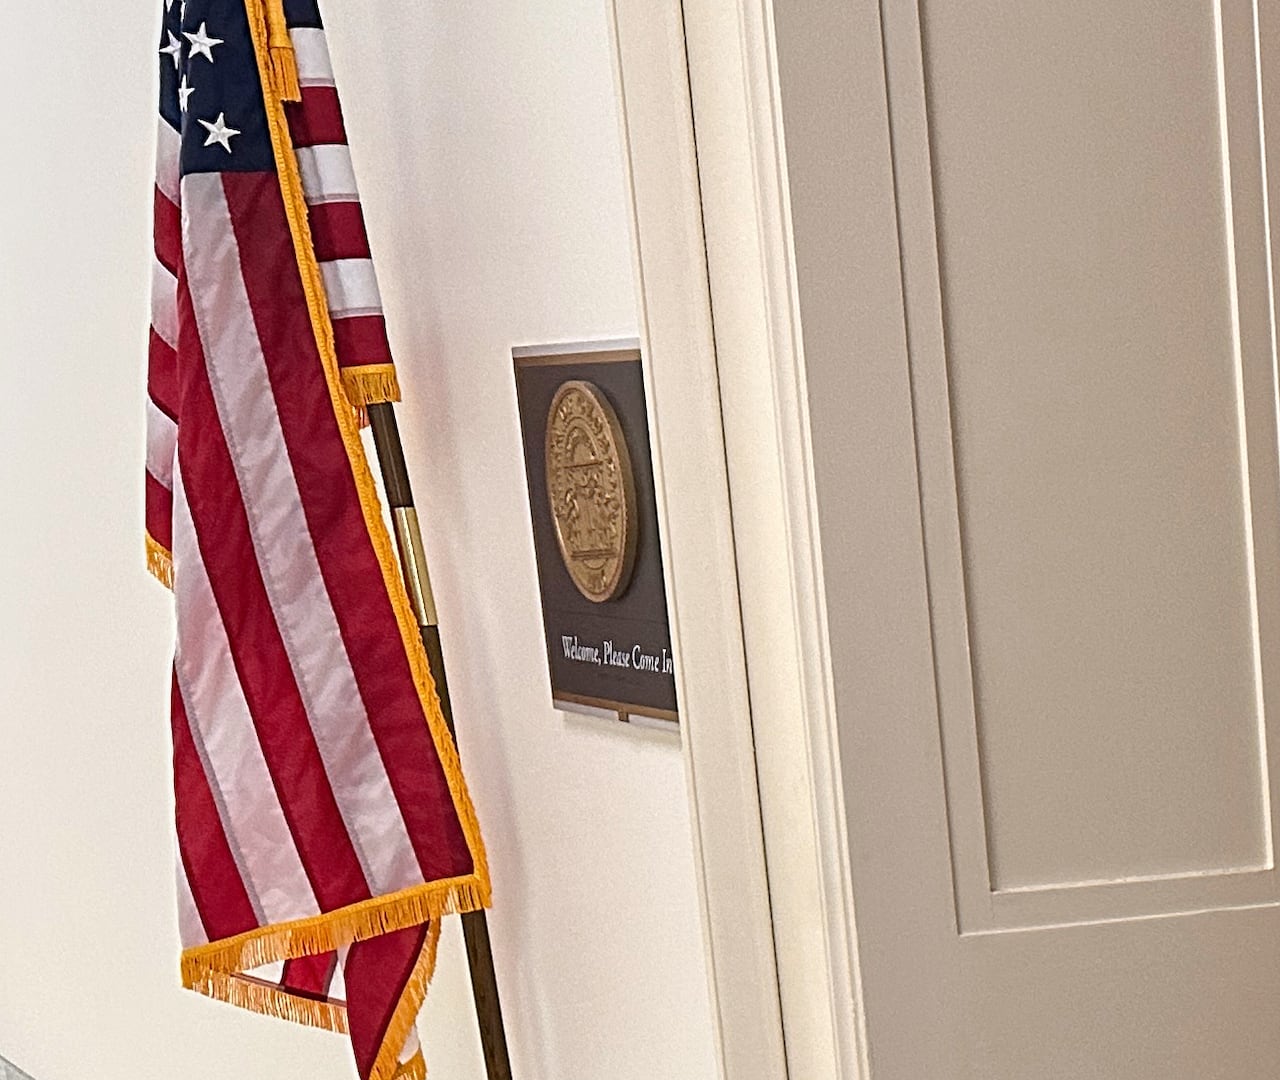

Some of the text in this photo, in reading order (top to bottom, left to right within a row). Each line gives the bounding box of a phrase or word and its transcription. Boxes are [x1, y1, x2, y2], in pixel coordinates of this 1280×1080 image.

[561, 635, 673, 675] Welcome, Please Come In
